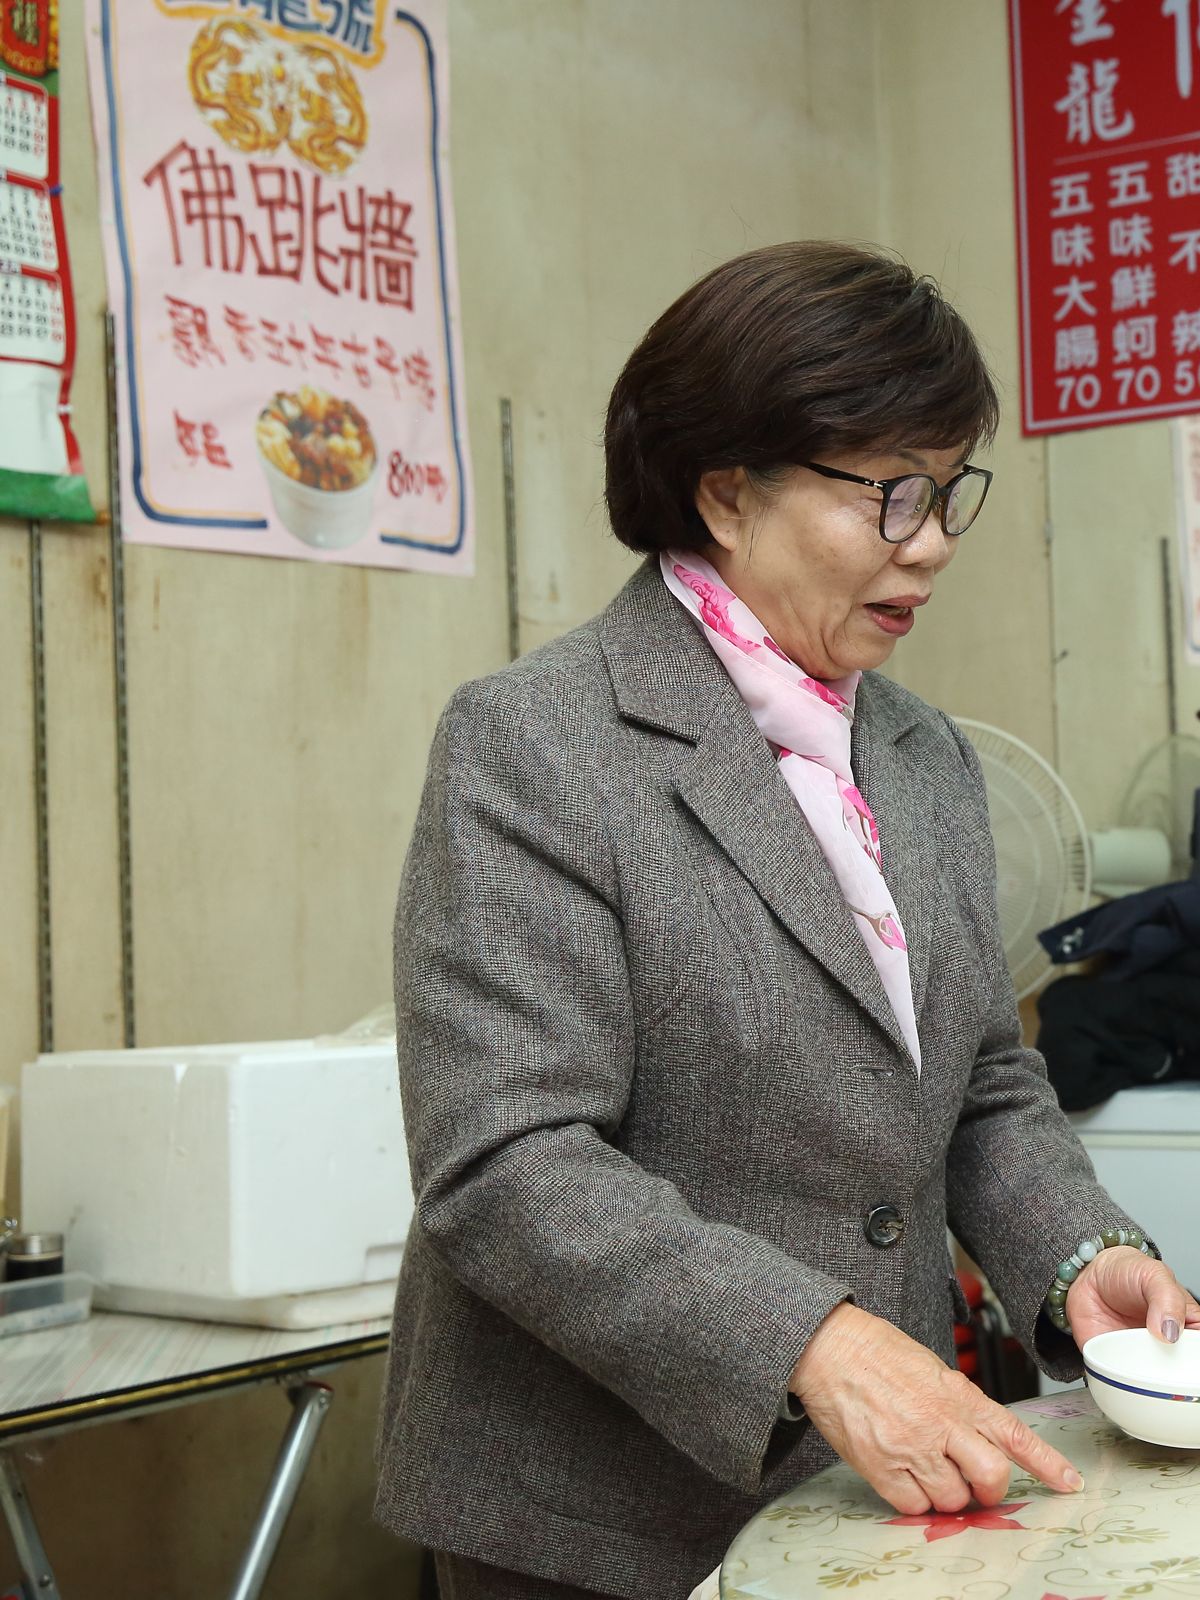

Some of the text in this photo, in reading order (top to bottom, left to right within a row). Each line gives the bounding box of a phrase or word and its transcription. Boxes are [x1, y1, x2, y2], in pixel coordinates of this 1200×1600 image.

[143, 139, 418, 312] 佛跳牆
[1052, 173, 1098, 371] 五味大腸
[1109, 162, 1157, 363] 五味鮮蚵
[1056, 374, 1101, 414] 70
[1113, 365, 1161, 402] 70
